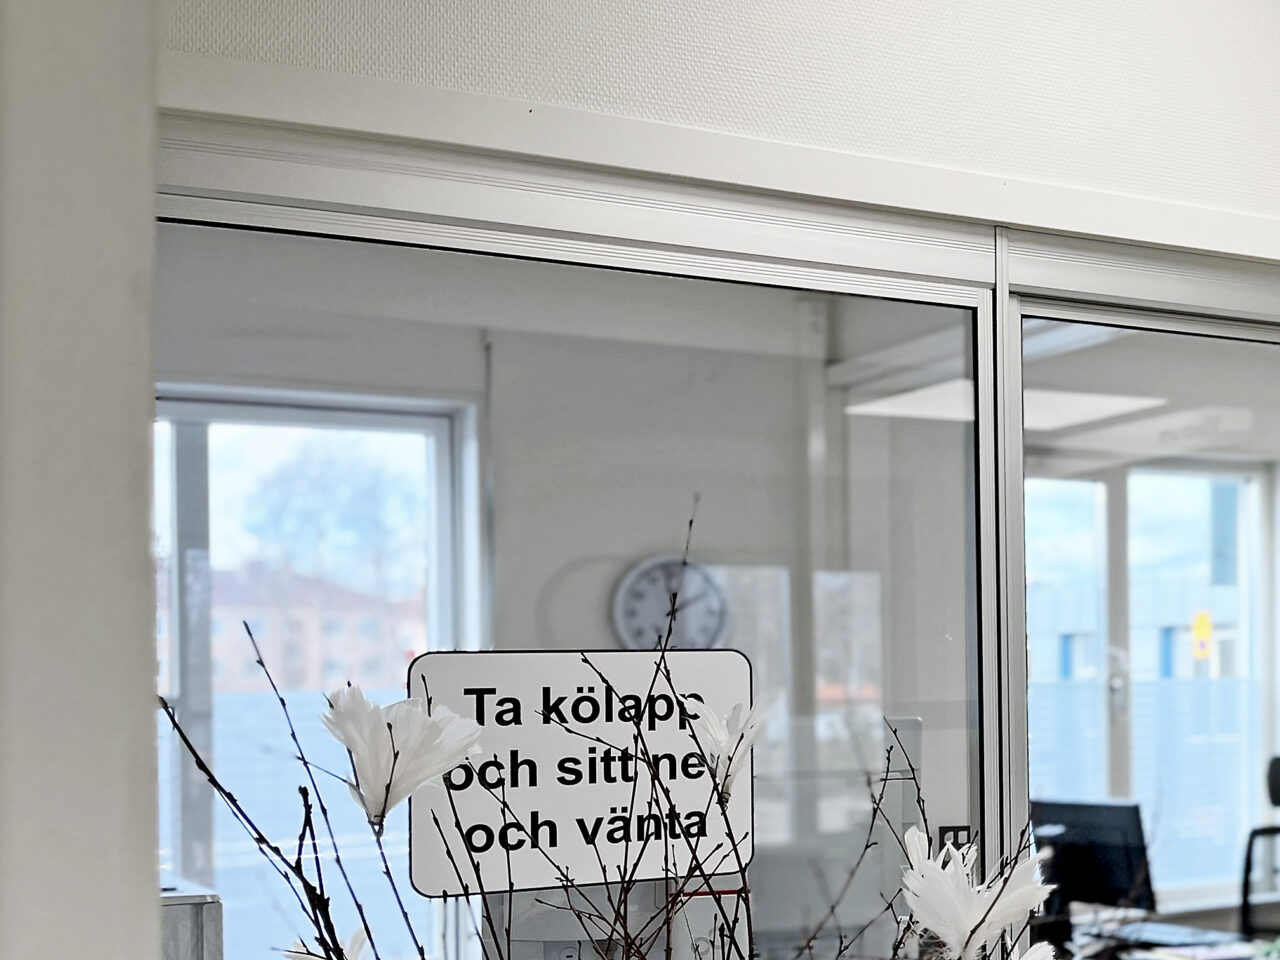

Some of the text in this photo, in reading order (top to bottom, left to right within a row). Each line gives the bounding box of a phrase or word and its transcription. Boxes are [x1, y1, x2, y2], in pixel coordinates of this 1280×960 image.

[463, 685, 704, 731] Ta kölapp
[444, 746, 716, 791] och sitt ne
[464, 806, 707, 853] och vänta
